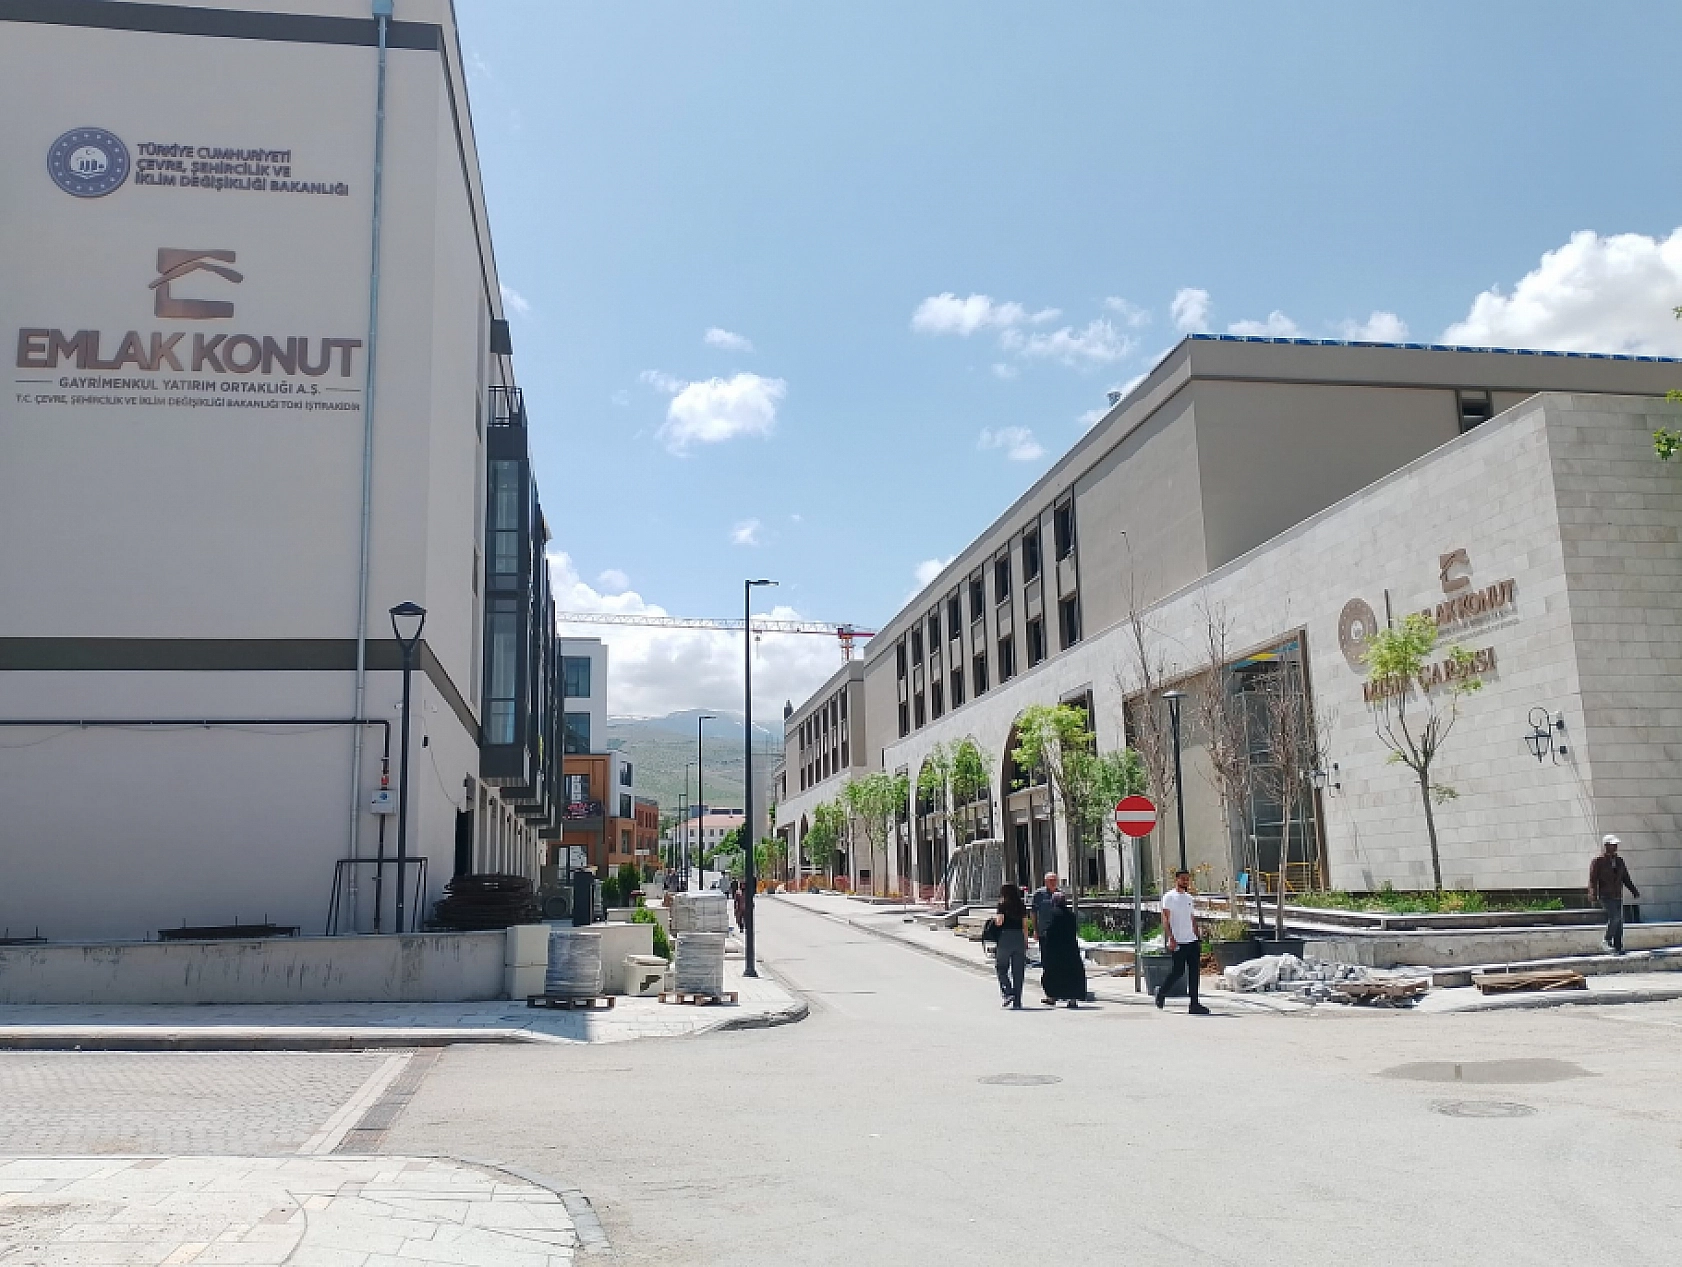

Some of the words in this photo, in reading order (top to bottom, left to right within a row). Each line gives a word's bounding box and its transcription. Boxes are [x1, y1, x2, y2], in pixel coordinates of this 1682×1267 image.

[137, 142, 194, 157] TÜRKİYE
[197, 147, 291, 163] CUMHURİYETİ
[191, 161, 270, 177] ŞEHİRCİLİK
[272, 165, 291, 178] VE
[136, 171, 177, 186] İKLİM
[180, 174, 266, 192] DEĞİŞİKLİĞİ
[270, 180, 349, 197] BAKANLIĞI
[16, 328, 186, 371] EMLAK
[190, 331, 362, 377] KONUT
[59, 375, 158, 391] GAYRİMENKUL
[163, 379, 216, 393] YATIRIM
[220, 380, 293, 395] ORTAKLIĞI
[296, 383, 322, 396] A.Ş.
[124, 396, 137, 406] VE
[227, 398, 279, 410] BAKANLIĞI
[1457, 578, 1515, 619] KONUT
